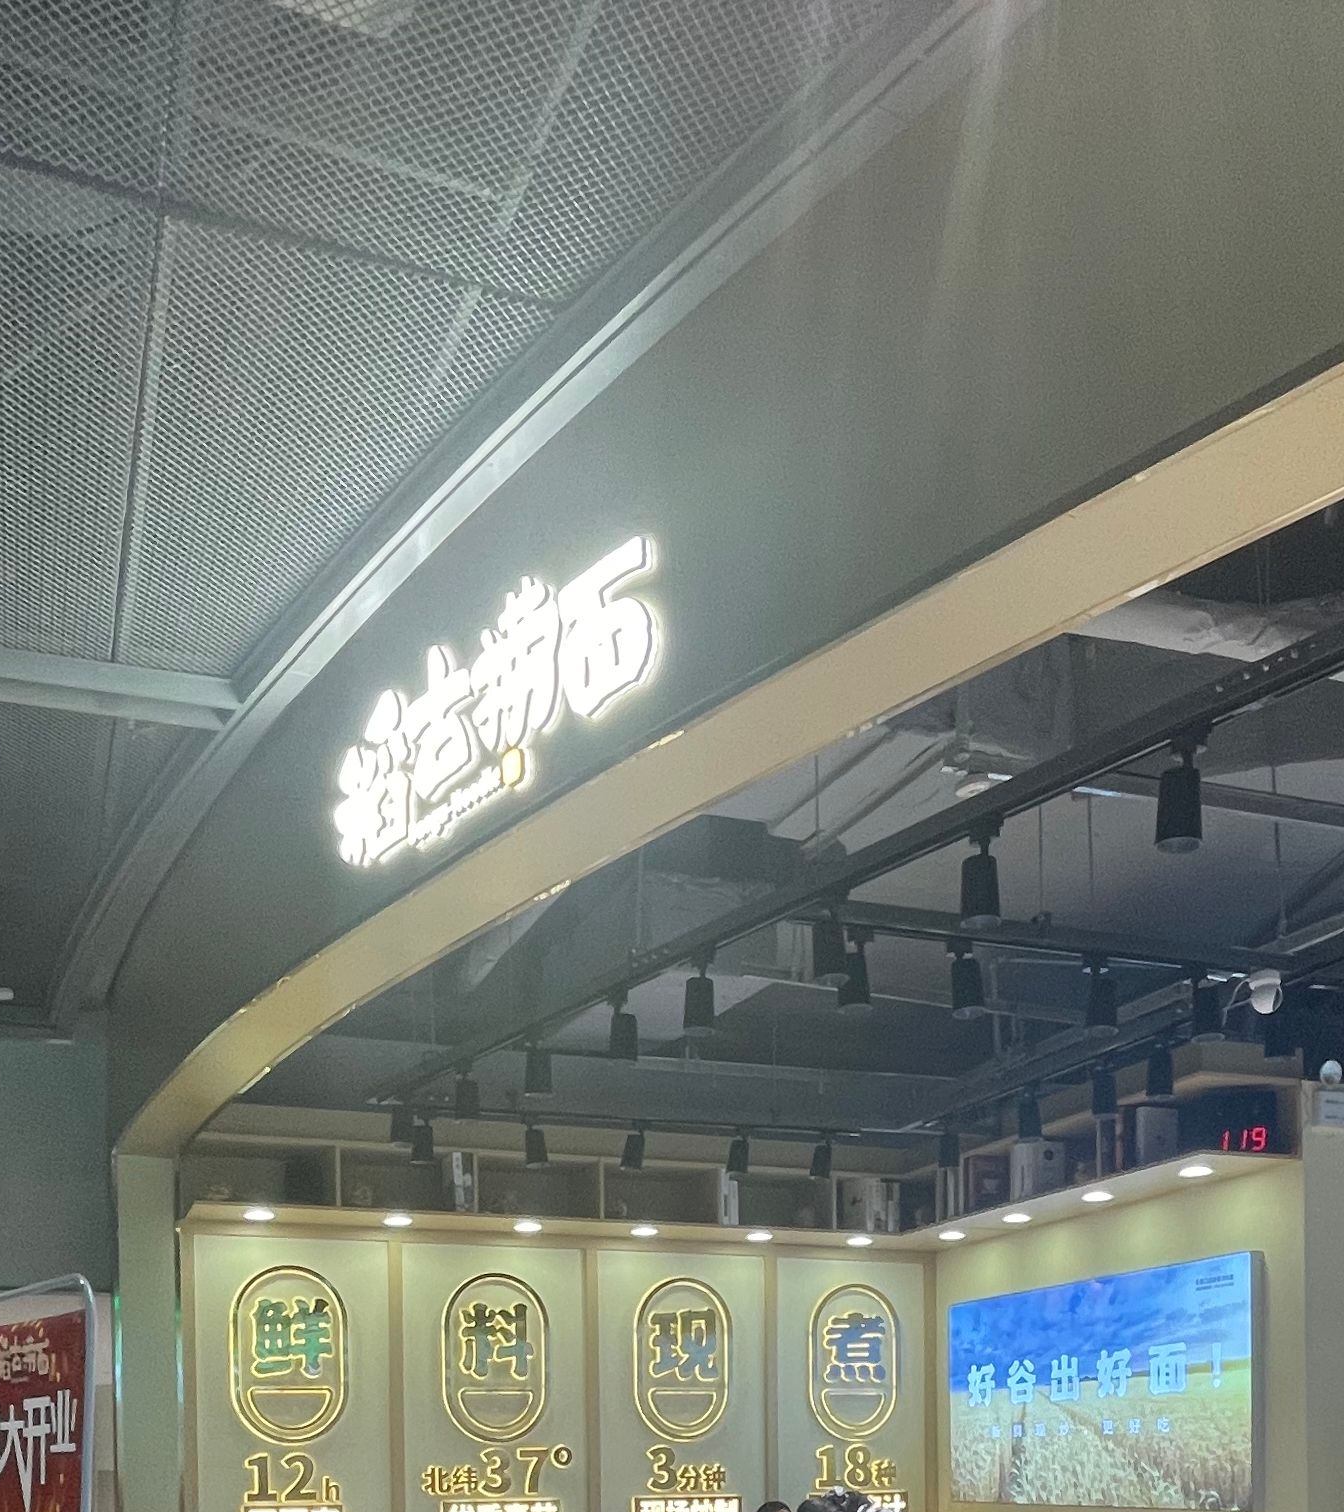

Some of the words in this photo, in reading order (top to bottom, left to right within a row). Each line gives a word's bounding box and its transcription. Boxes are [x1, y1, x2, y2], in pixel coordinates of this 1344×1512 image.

[249, 1298, 332, 1379] 鲜
[459, 1302, 536, 1380] 料
[648, 1307, 720, 1382] 现
[824, 1311, 888, 1382] 煮
[645, 1444, 727, 1492] 3分钟
